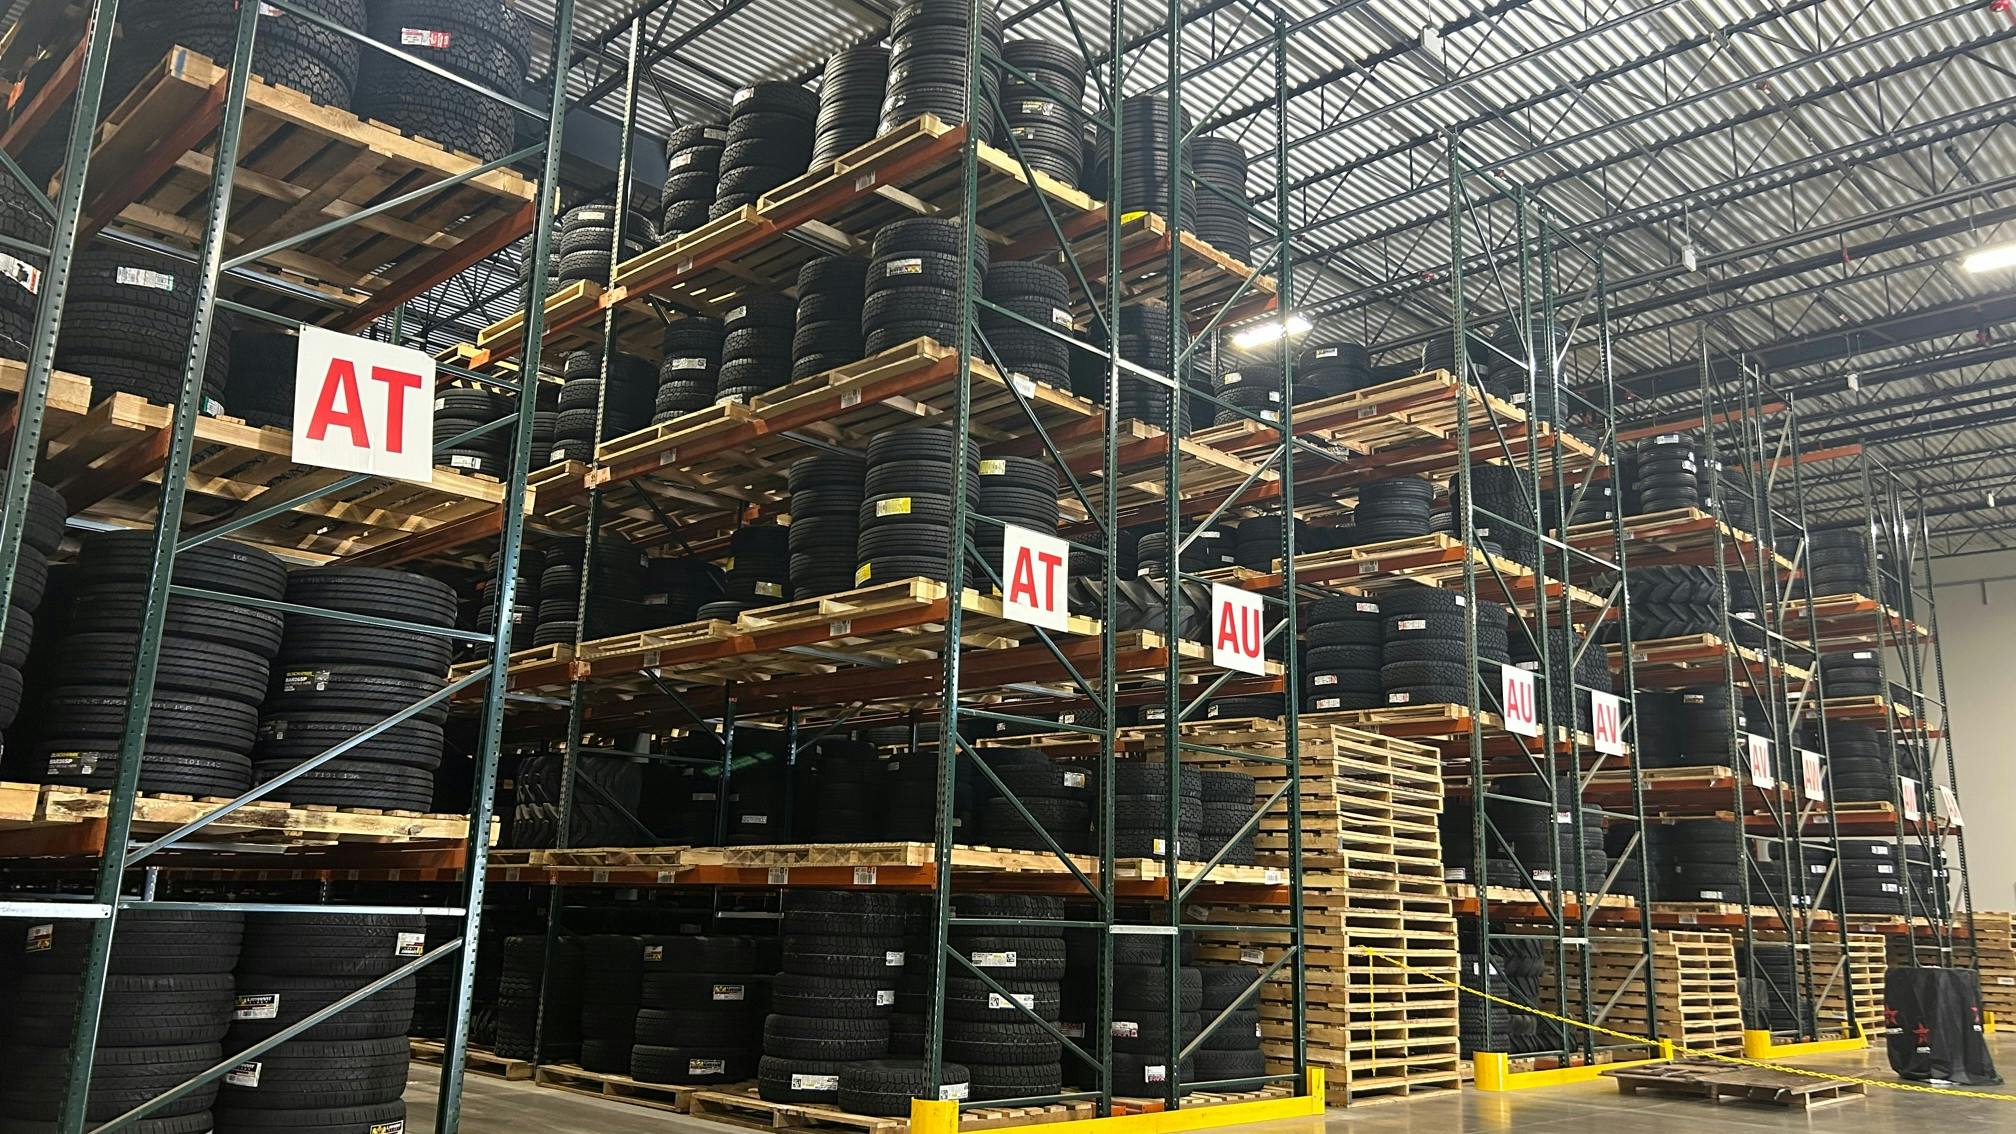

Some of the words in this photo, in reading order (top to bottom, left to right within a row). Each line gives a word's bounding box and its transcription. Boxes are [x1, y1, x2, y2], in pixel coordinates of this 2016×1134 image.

[305, 357, 423, 454] AT
[1009, 546, 1063, 612] AT
[1217, 600, 1260, 659] AU
[1507, 678, 1533, 724] AU
[1596, 703, 1617, 744] AV
[1753, 743, 1768, 780] AV
[1804, 759, 1820, 793] AW
